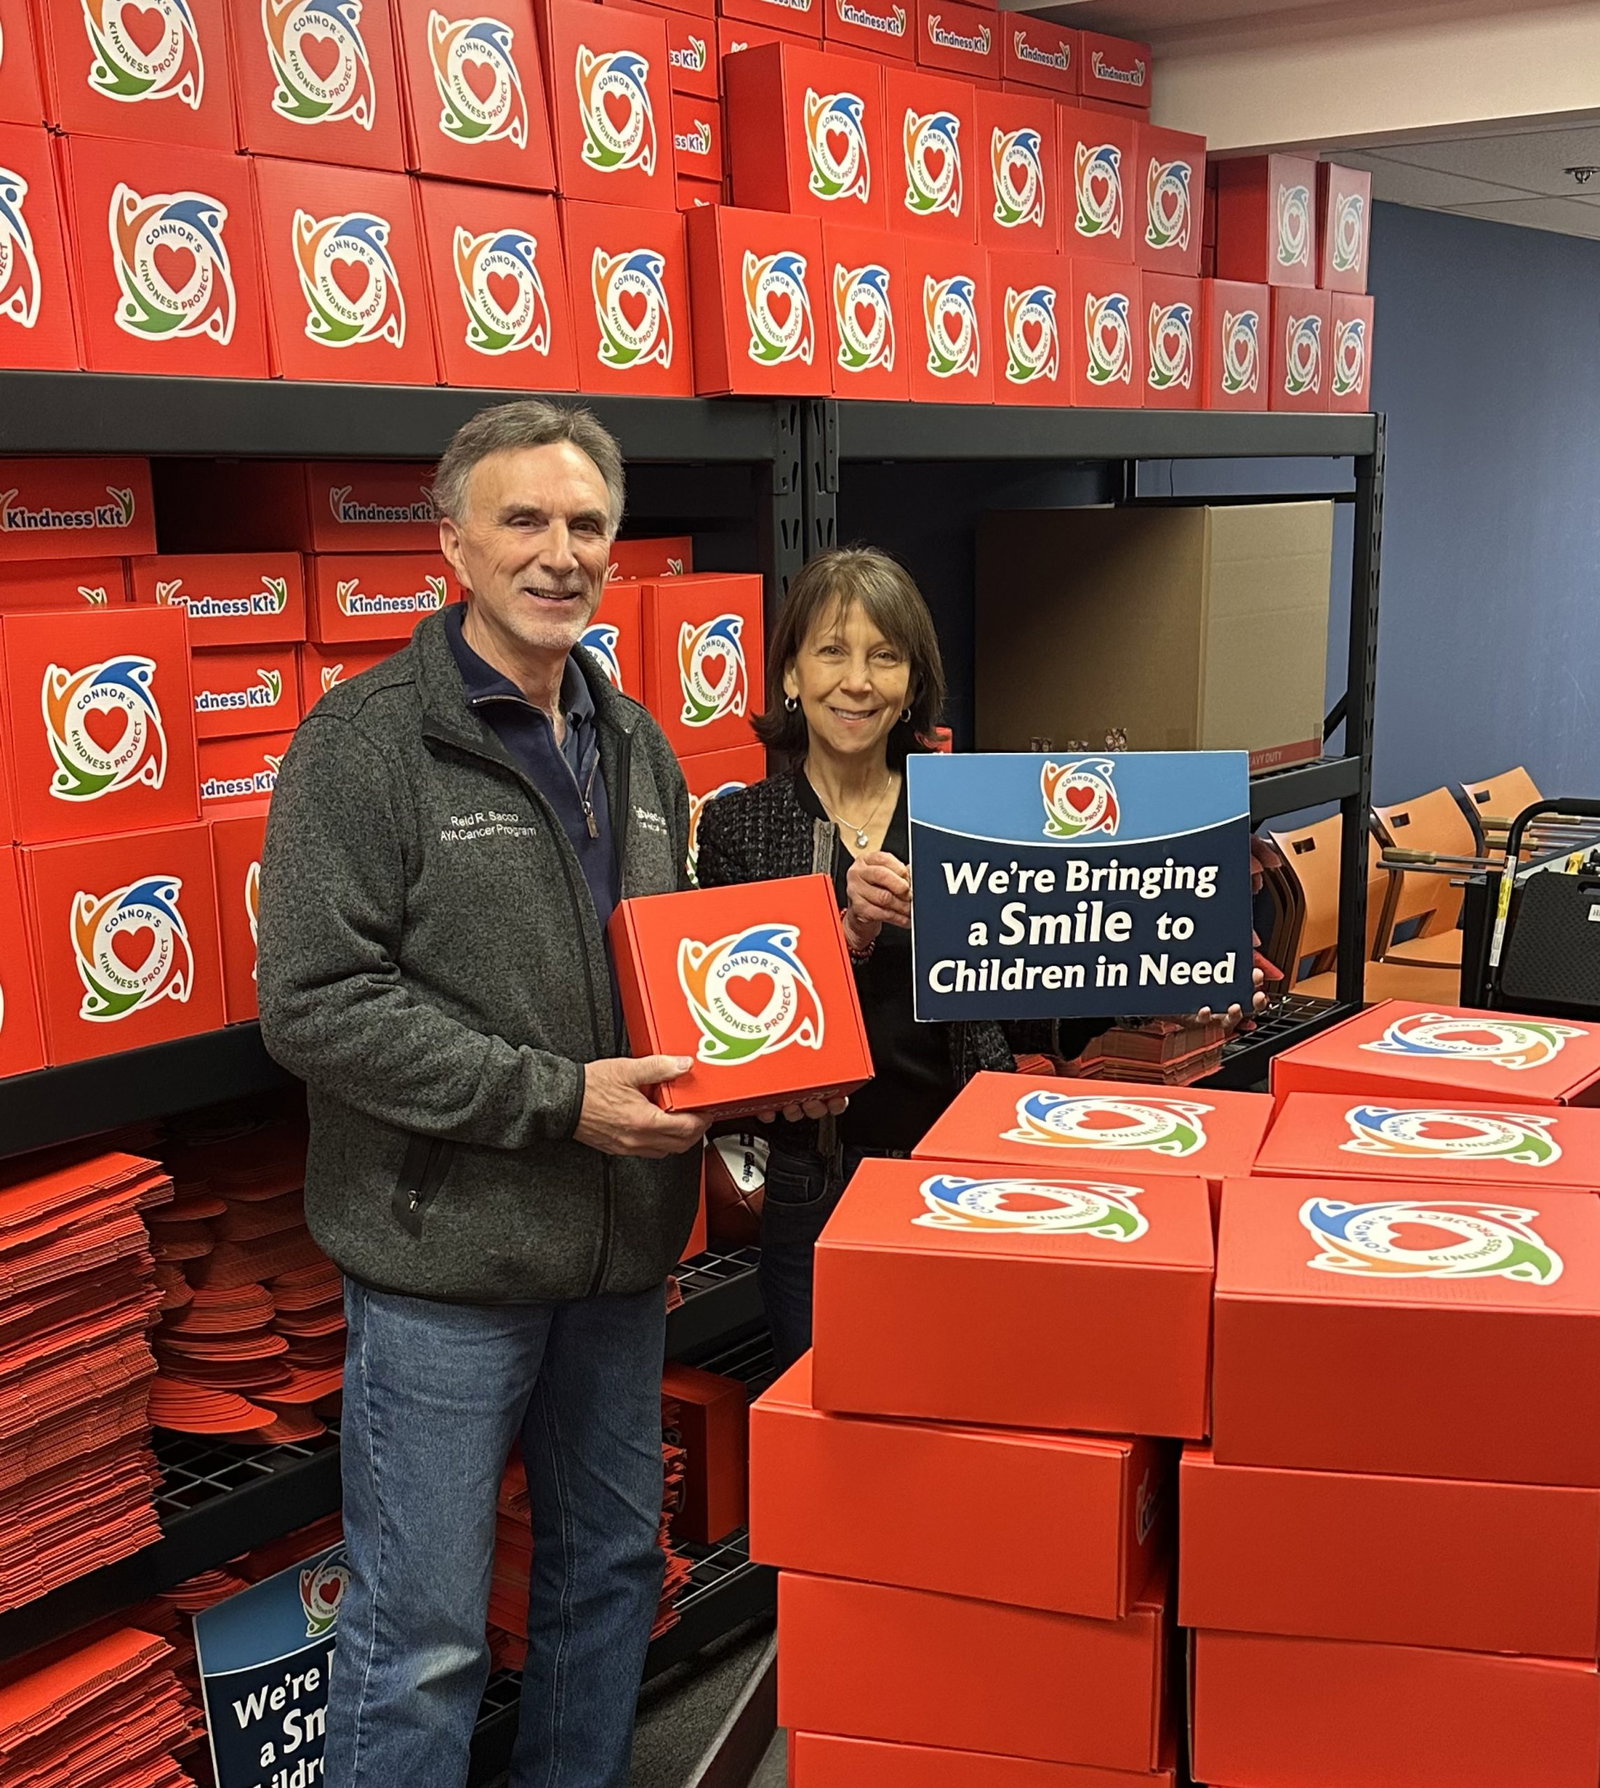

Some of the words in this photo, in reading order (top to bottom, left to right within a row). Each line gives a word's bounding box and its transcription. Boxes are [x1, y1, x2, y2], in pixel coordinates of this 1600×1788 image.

[294, 15, 345, 44] CONNOR'S
[844, 7, 885, 29] Kindness
[888, 18, 900, 34] Kit
[108, 21, 150, 74] KINDNESS
[152, 30, 178, 74] PROJECT
[936, 30, 972, 49] Kindness
[974, 37, 987, 52] Kit
[455, 42, 500, 69] CONNOR'S
[683, 52, 698, 68] Kit
[1020, 46, 1053, 65] Kindness
[1055, 52, 1064, 68] Kit
[290, 50, 326, 98] KINDNESS
[329, 56, 352, 98] PROJECT
[1098, 66, 1129, 82] Kindness
[1130, 70, 1141, 84] Kit
[452, 74, 486, 120] KINDNESS
[487, 80, 507, 120] PROJECT
[598, 75, 636, 100] CONNOR'S
[595, 106, 621, 149] KINDNESS
[622, 111, 640, 148] PROJECT
[689, 136, 704, 151] Kit
[819, 142, 841, 180] KINDNESS
[146, 224, 203, 254] CONNOR'S
[324, 240, 374, 266] CONNOR'S
[480, 254, 524, 279] CONNOR'S
[140, 261, 179, 311] KINDNESS
[181, 267, 209, 311] PROJECT
[614, 274, 652, 296] CONNOR'S
[320, 276, 358, 321] KINDNESS
[359, 278, 382, 320] PROJECT
[478, 288, 510, 330] KINDNESS
[511, 290, 530, 330] PROJECT
[611, 306, 637, 345] KINDNESS
[638, 307, 656, 345] PROJECT
[759, 306, 783, 343] KINDNESS
[7, 510, 93, 528] Kindness
[97, 508, 124, 525] Kit
[342, 504, 408, 520] Kindness
[412, 504, 432, 520] Kit
[172, 599, 248, 615] ndness
[253, 596, 276, 612] Kit
[349, 596, 414, 612] Kindness
[418, 594, 436, 608] Kit
[694, 672, 716, 702] KINDNESS
[717, 664, 734, 701] PROJECT
[77, 688, 135, 710] CONNOR'S
[195, 694, 246, 709] dness
[250, 688, 271, 704] Kit
[71, 730, 112, 770] KINDNESS
[114, 721, 142, 768] PROJECT
[201, 781, 252, 796] dness
[450, 814, 474, 827] Reid
[488, 811, 518, 822] Sacco
[1057, 798, 1083, 823] KINDNESS
[440, 830, 458, 841] AYA
[458, 826, 495, 840] Cancer
[496, 824, 536, 838] Program
[941, 860, 1056, 894] We're
[1066, 858, 1218, 899] Bringing
[104, 909, 161, 933] CONNOR'S
[968, 921, 988, 946] a
[998, 900, 1132, 946] Smile
[1156, 912, 1195, 940] to
[99, 952, 140, 989] KINDNESS
[141, 939, 168, 986] PROJECT
[716, 956, 780, 978] CONNOR'S
[928, 958, 1085, 993] Children
[1095, 956, 1128, 987] in
[1138, 952, 1236, 986] Need
[714, 997, 762, 1034] KINDNESS
[764, 985, 791, 1030] PROJECT
[1415, 1214, 1499, 1237] PROJECT
[1428, 1239, 1503, 1261] KINDNESS
[232, 1668, 320, 1728] We're
[260, 1742, 276, 1768] a
